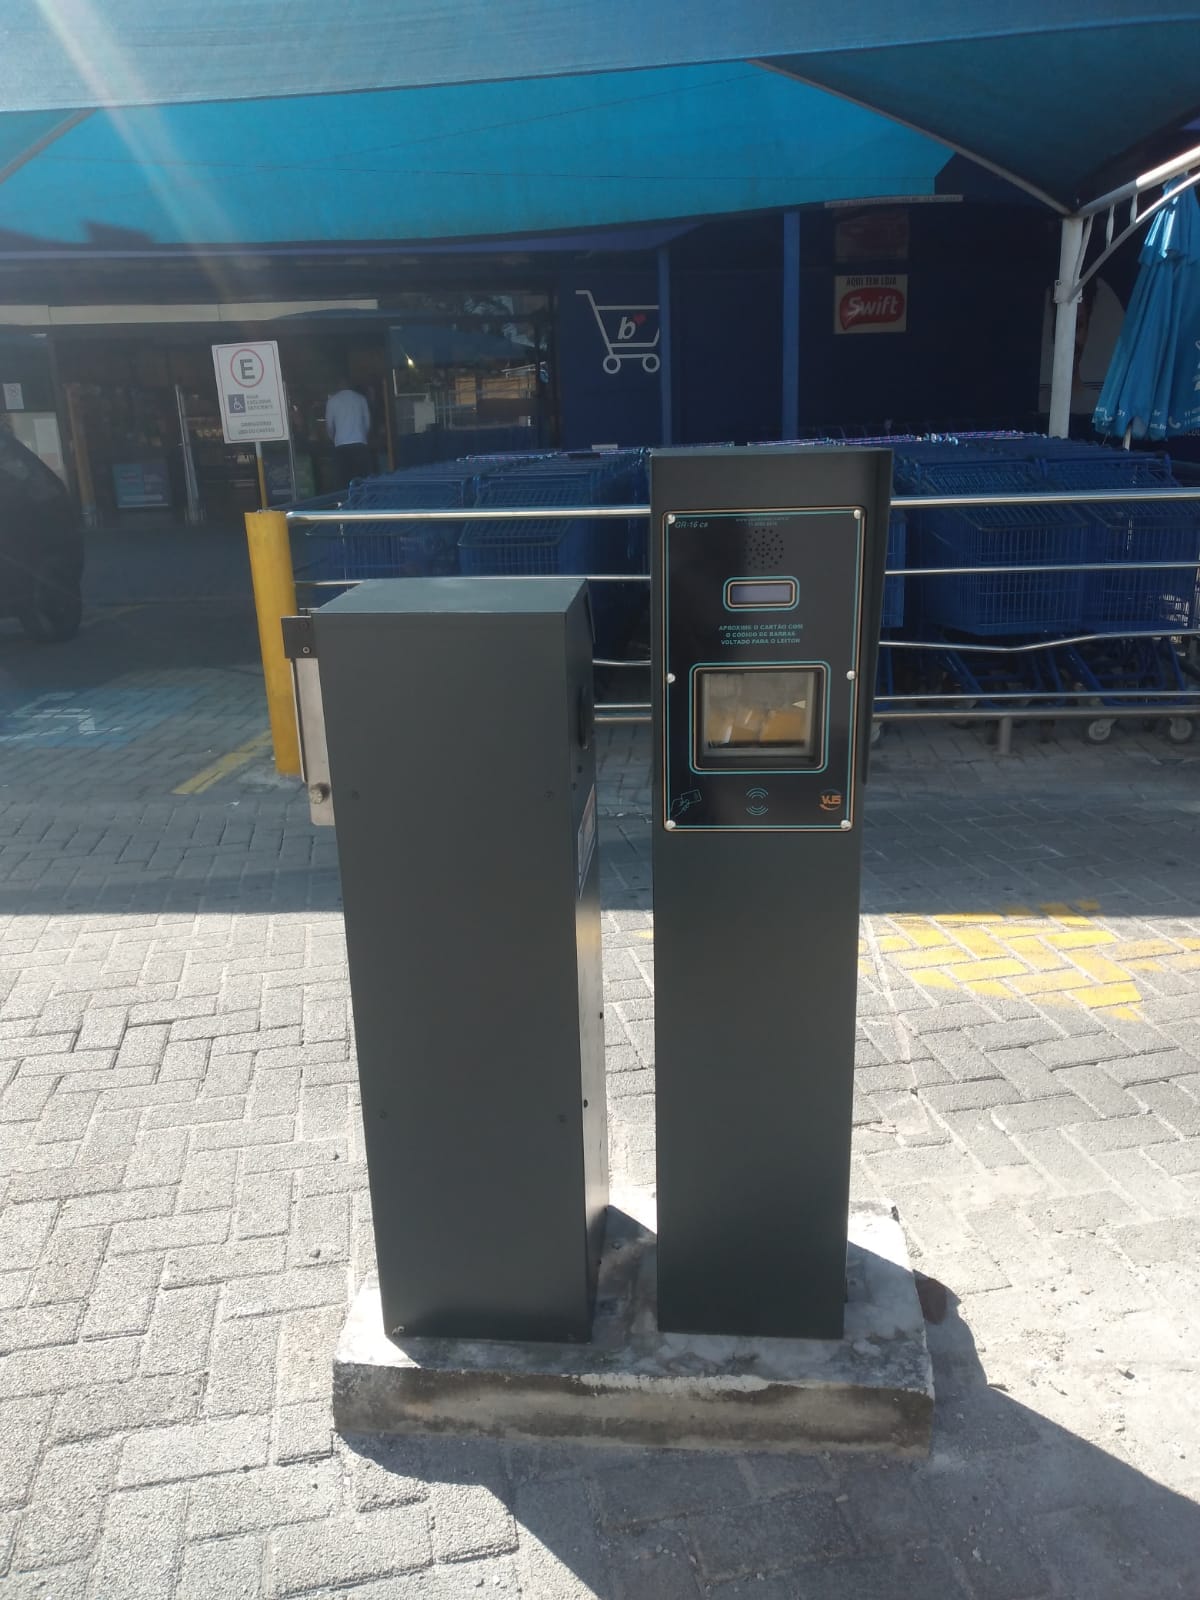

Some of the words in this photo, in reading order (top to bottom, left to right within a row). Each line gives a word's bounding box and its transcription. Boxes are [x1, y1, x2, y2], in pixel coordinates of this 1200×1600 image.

[847, 295, 899, 317] Swift
[617, 316, 636, 340] b
[240, 359, 255, 379] E
